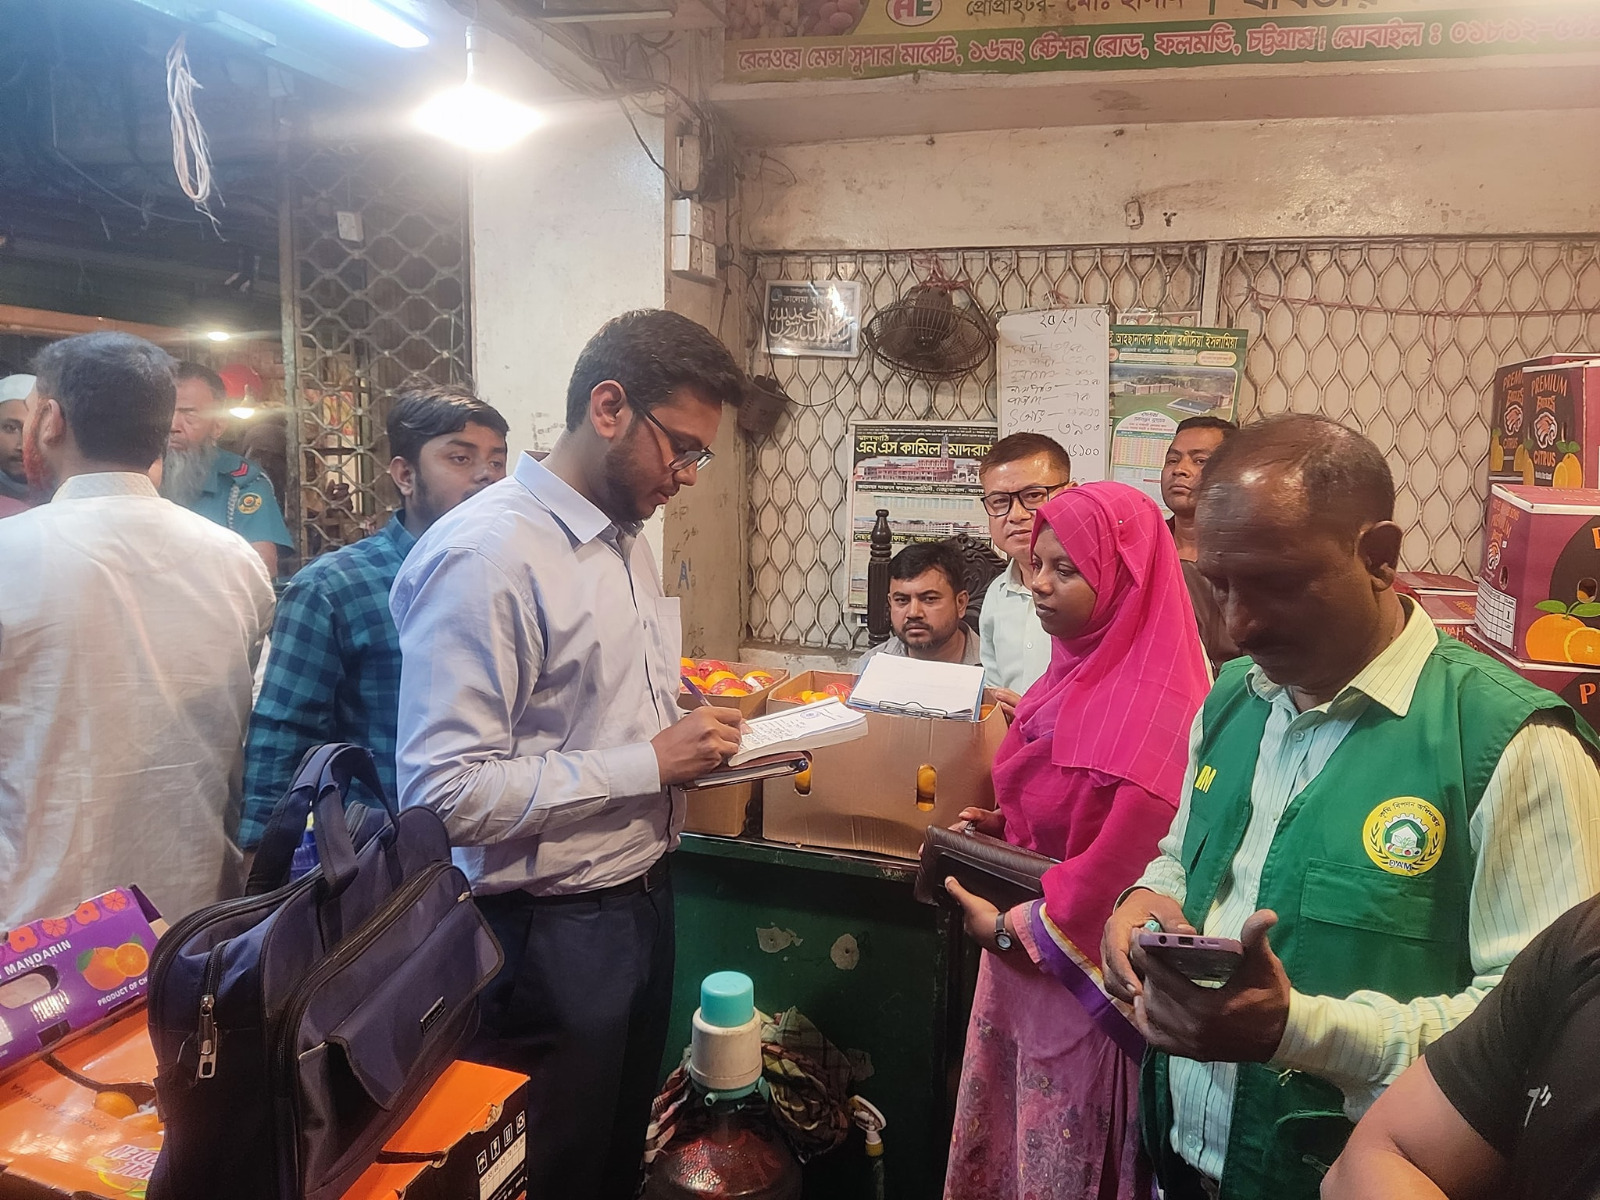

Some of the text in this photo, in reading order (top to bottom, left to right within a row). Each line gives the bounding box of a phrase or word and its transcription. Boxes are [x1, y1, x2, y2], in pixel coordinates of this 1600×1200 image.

[738, 47, 803, 71] রেলওয়ে
[848, 44, 896, 75] সুপার
[899, 35, 964, 66] মার্কেট,
[1093, 33, 1149, 60] রোড,
[1332, 17, 1425, 49] মোবাইল
[1205, 332, 1238, 349] ইসলামিয়া
[1531, 373, 1568, 397] PREMIUM
[856, 441, 877, 454] এন
[878, 441, 898, 454] এস
[899, 437, 942, 455] কামিল
[1534, 450, 1556, 467] CITRUS
[1388, 859, 1413, 871] DAM
[4, 939, 72, 976] MANDARIN
[97, 986, 129, 1006] PRODUCT
[128, 981, 138, 990] OF
